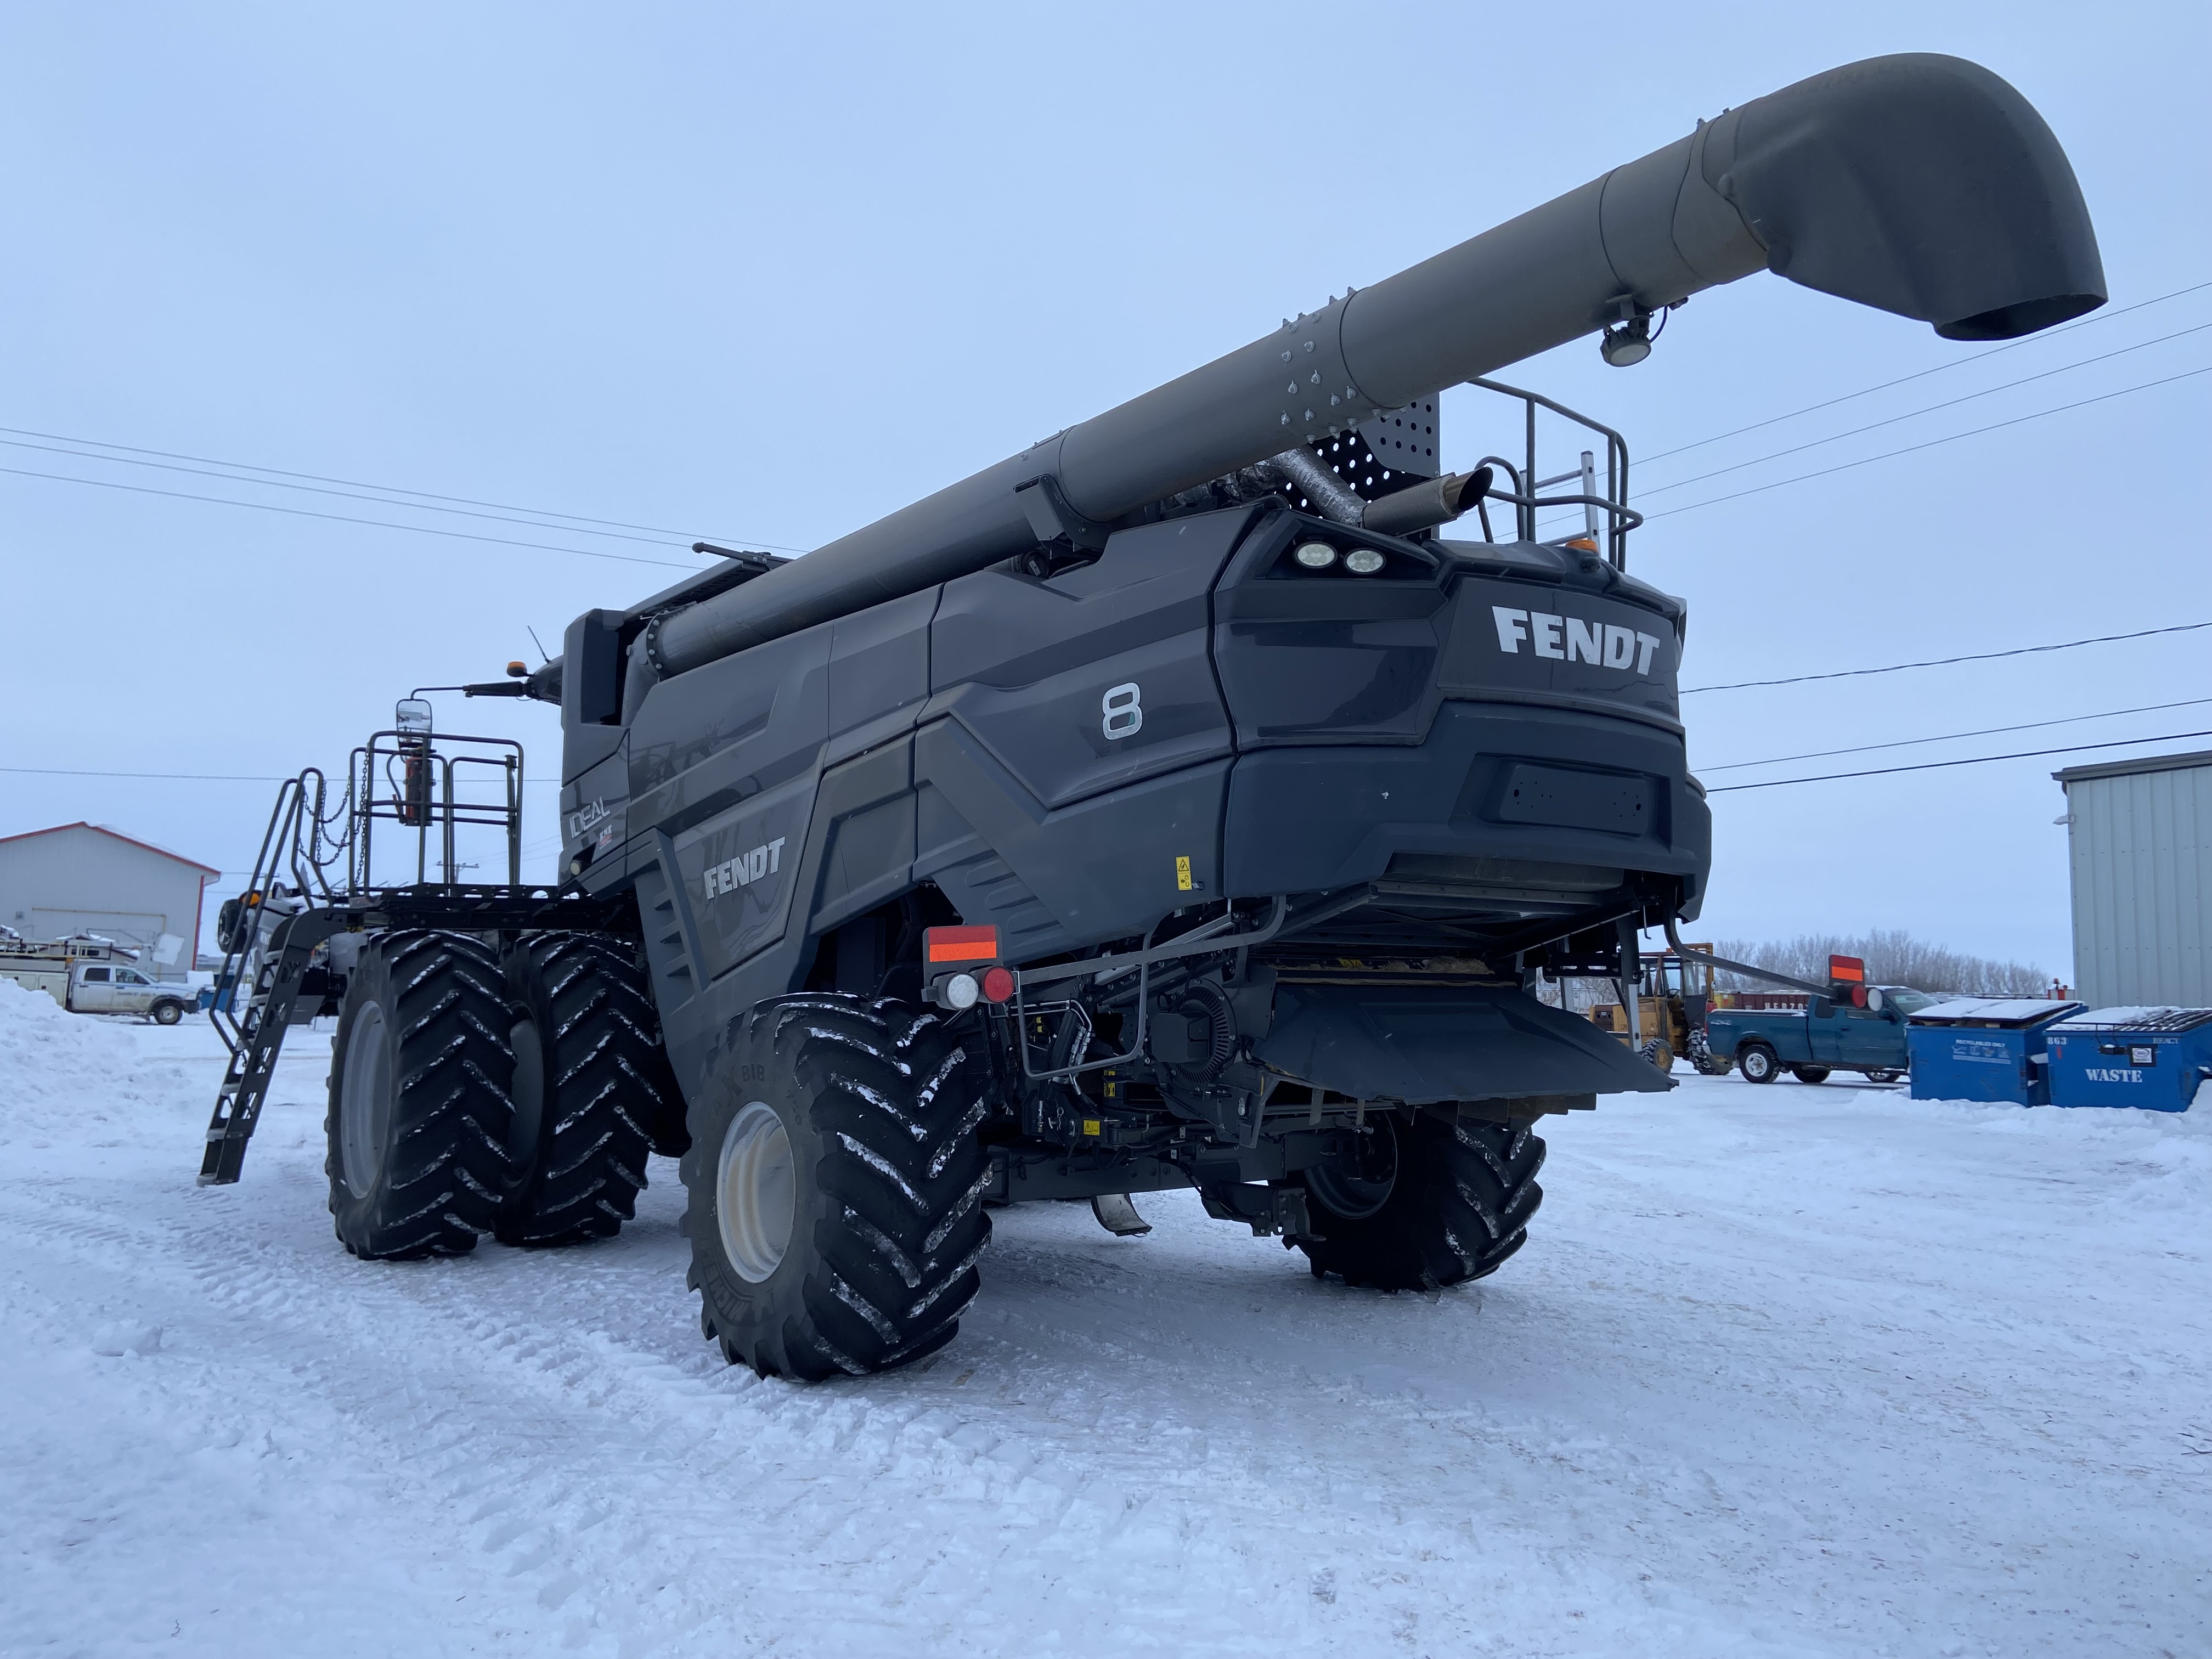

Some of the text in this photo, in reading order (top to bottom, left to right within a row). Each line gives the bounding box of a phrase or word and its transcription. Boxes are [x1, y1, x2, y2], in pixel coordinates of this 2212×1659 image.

[1492, 606, 1660, 676] FENDT
[1102, 682, 1143, 740] 8
[569, 796, 611, 839] IDEAL
[703, 836, 786, 900] FENDT
[2047, 1036, 2067, 1045] 863
[2085, 1069, 2143, 1083] WASTE
